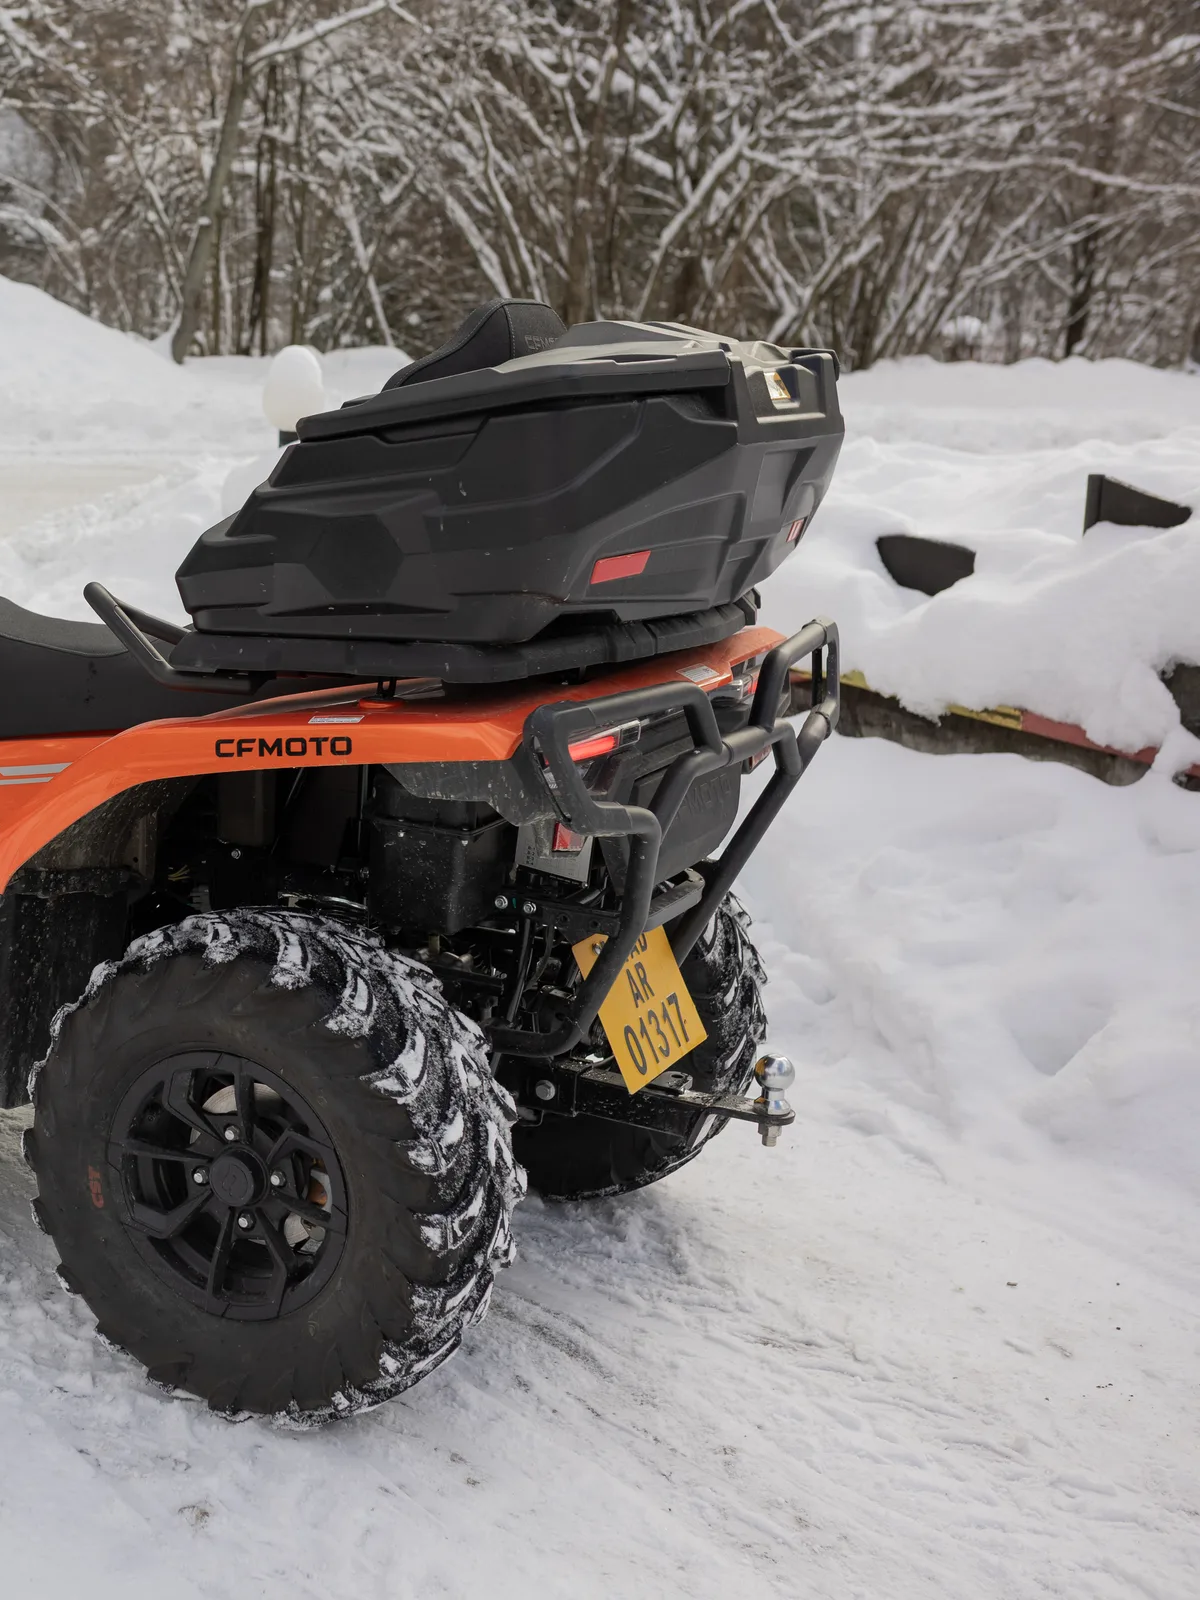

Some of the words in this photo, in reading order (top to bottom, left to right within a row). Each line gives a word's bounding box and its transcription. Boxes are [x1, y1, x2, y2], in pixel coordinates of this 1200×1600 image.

[215, 736, 353, 758] CFMOTO
[626, 961, 655, 1009] AR
[623, 992, 690, 1076] 01317
